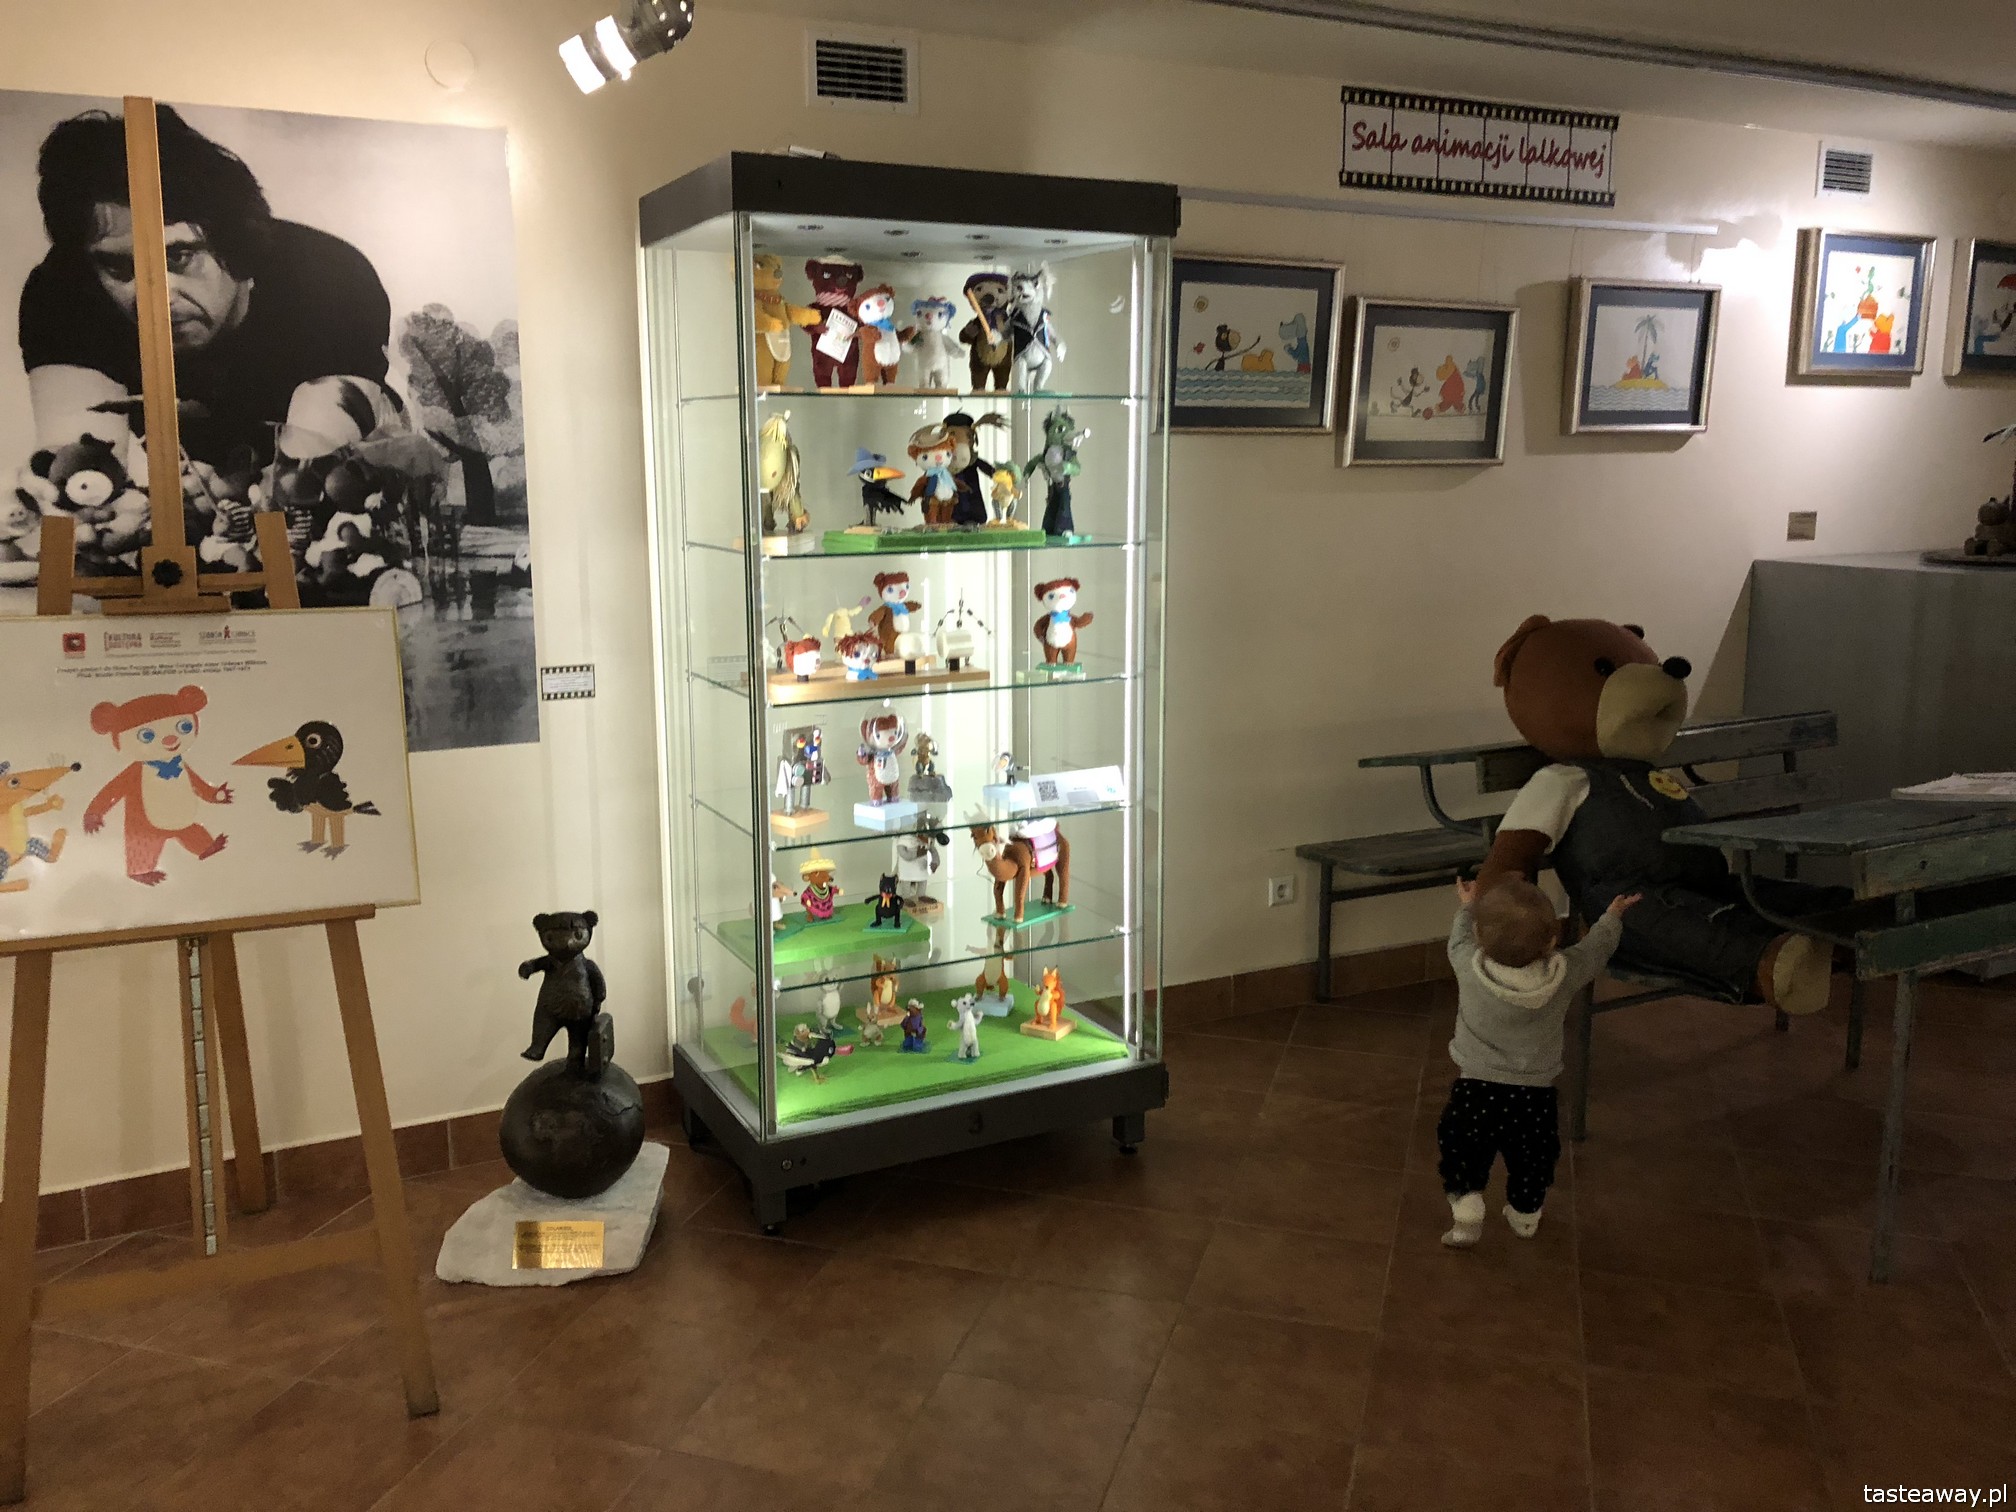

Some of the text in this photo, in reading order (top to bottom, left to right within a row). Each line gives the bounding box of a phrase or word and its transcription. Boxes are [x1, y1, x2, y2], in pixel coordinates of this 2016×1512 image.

[1352, 121, 1607, 178] Sala animacji lalkowej
